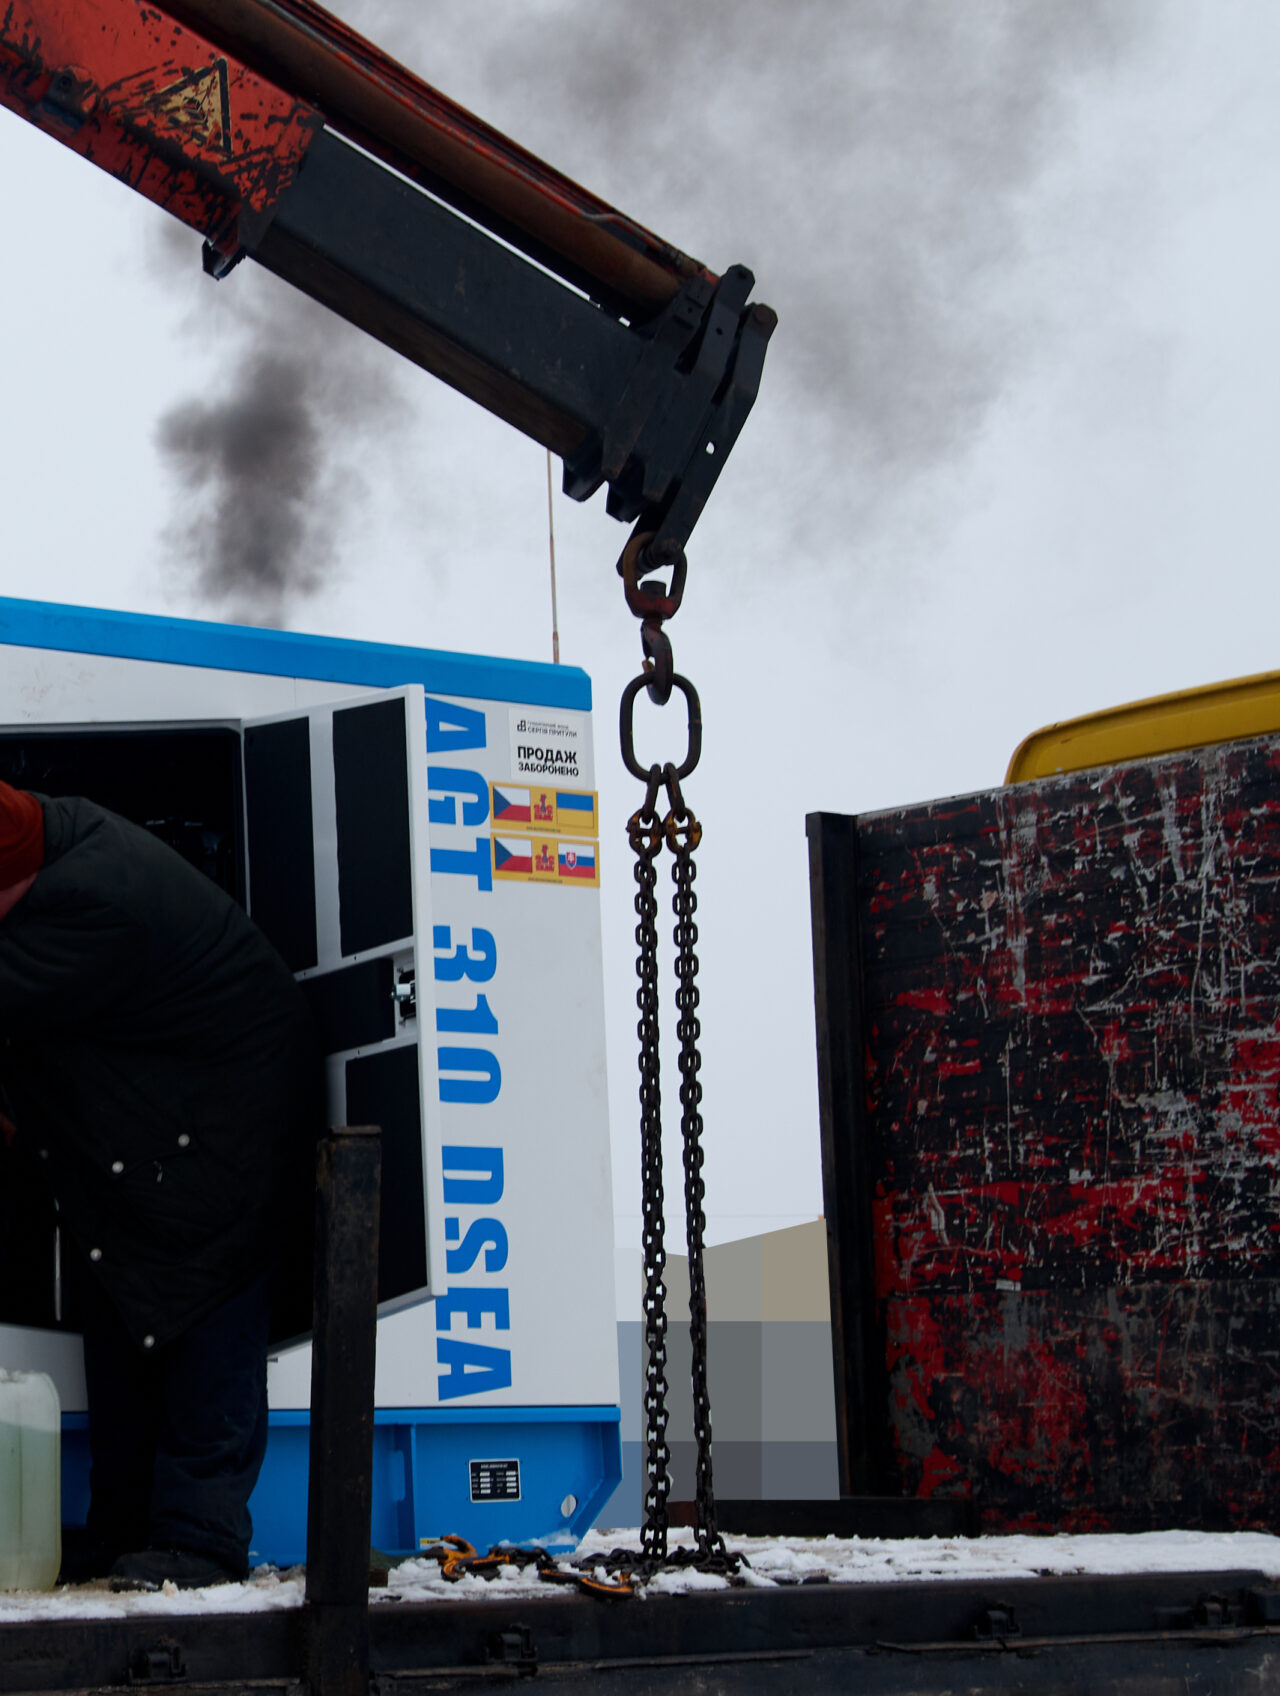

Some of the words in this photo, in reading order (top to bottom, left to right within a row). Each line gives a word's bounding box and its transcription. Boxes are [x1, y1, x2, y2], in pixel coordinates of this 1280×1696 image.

[424, 696, 493, 892] AGT
[517, 746, 577, 765] ПРОДАЖ
[518, 761, 580, 777] ЗАБОРОНЕНО
[433, 925, 502, 1104] 310
[436, 1145, 512, 1401] DSEA
